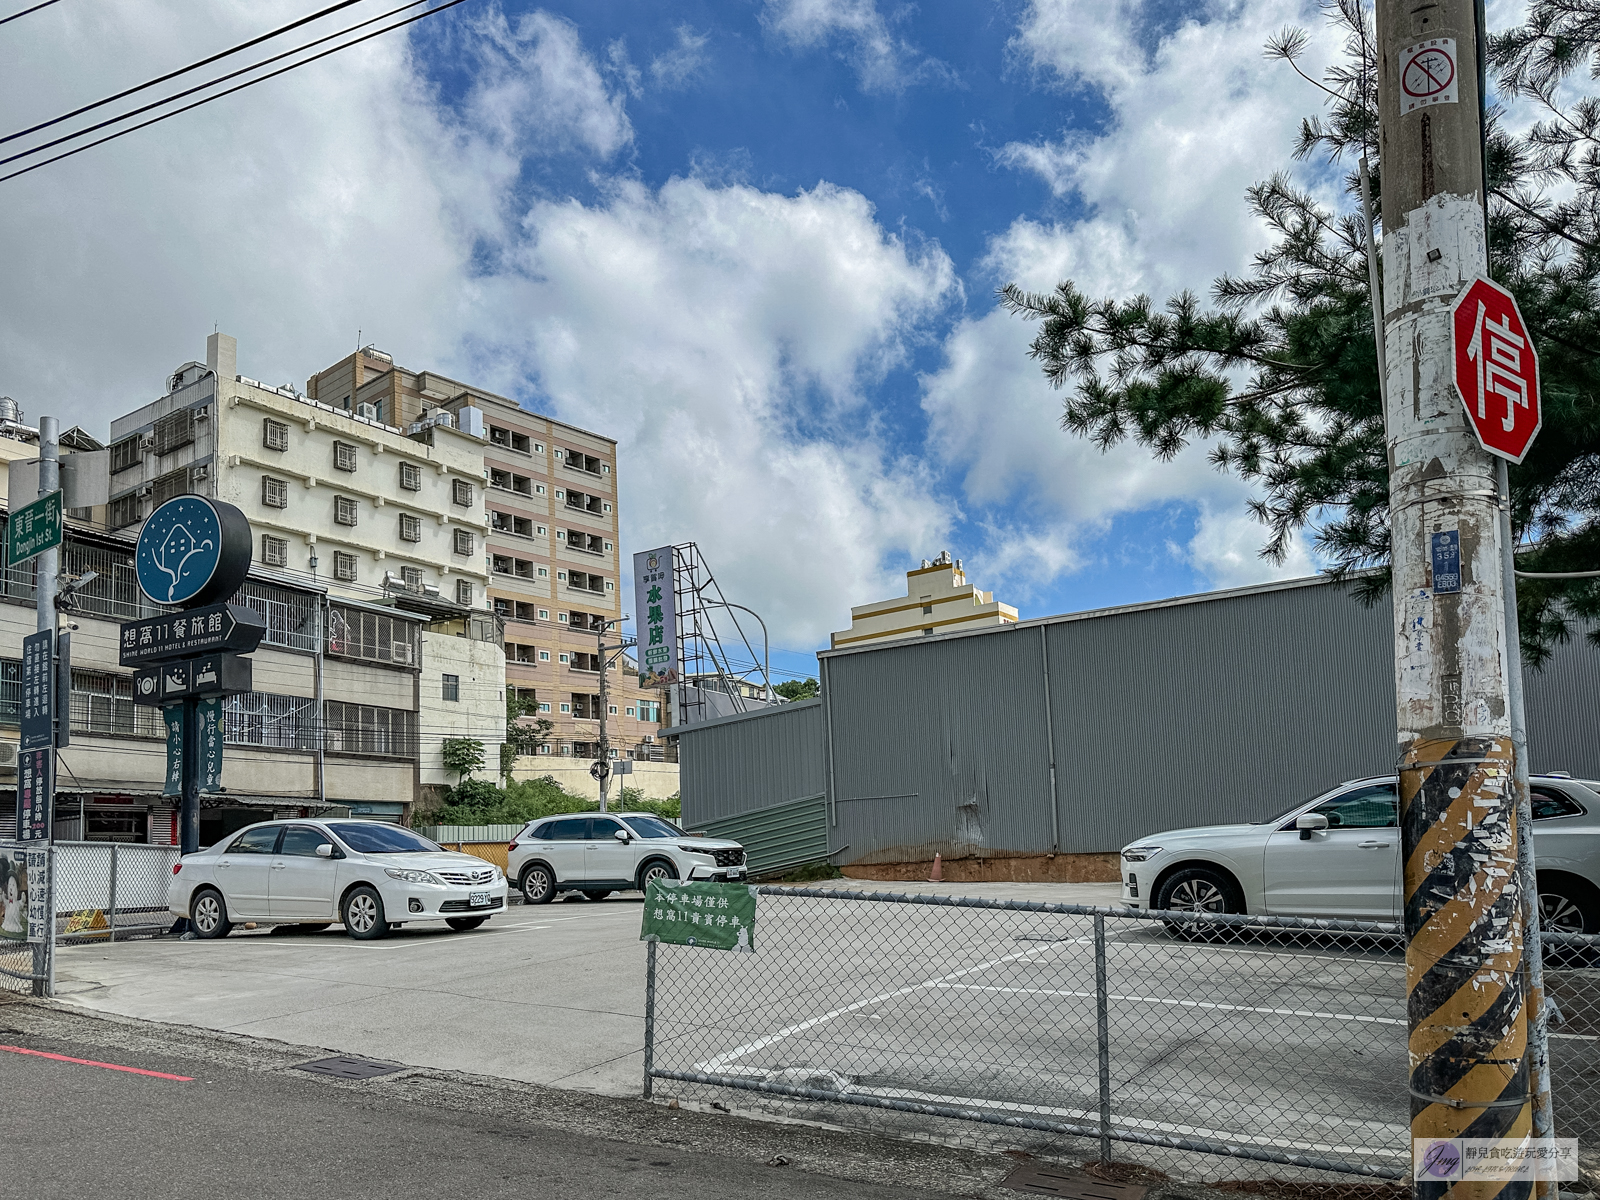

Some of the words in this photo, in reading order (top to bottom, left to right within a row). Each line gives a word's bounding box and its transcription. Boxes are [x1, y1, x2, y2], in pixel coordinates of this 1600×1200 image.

[467, 299, 529, 432] 停
[14, 499, 56, 539] 東晉一街
[16, 536, 35, 556] Dongjin
[35, 531, 44, 547] 1st
[123, 611, 223, 649] 想窩11餐旅館
[646, 584, 664, 646] 水果店
[140, 646, 157, 656] WORLD
[164, 643, 182, 652] HOTEL
[187, 634, 223, 647] RESTAURANT
[206, 710, 217, 786] 慢行當心兒童
[653, 907, 741, 928] 想窩11貴賓停車
[654, 892, 729, 909] 本停車場僅供
